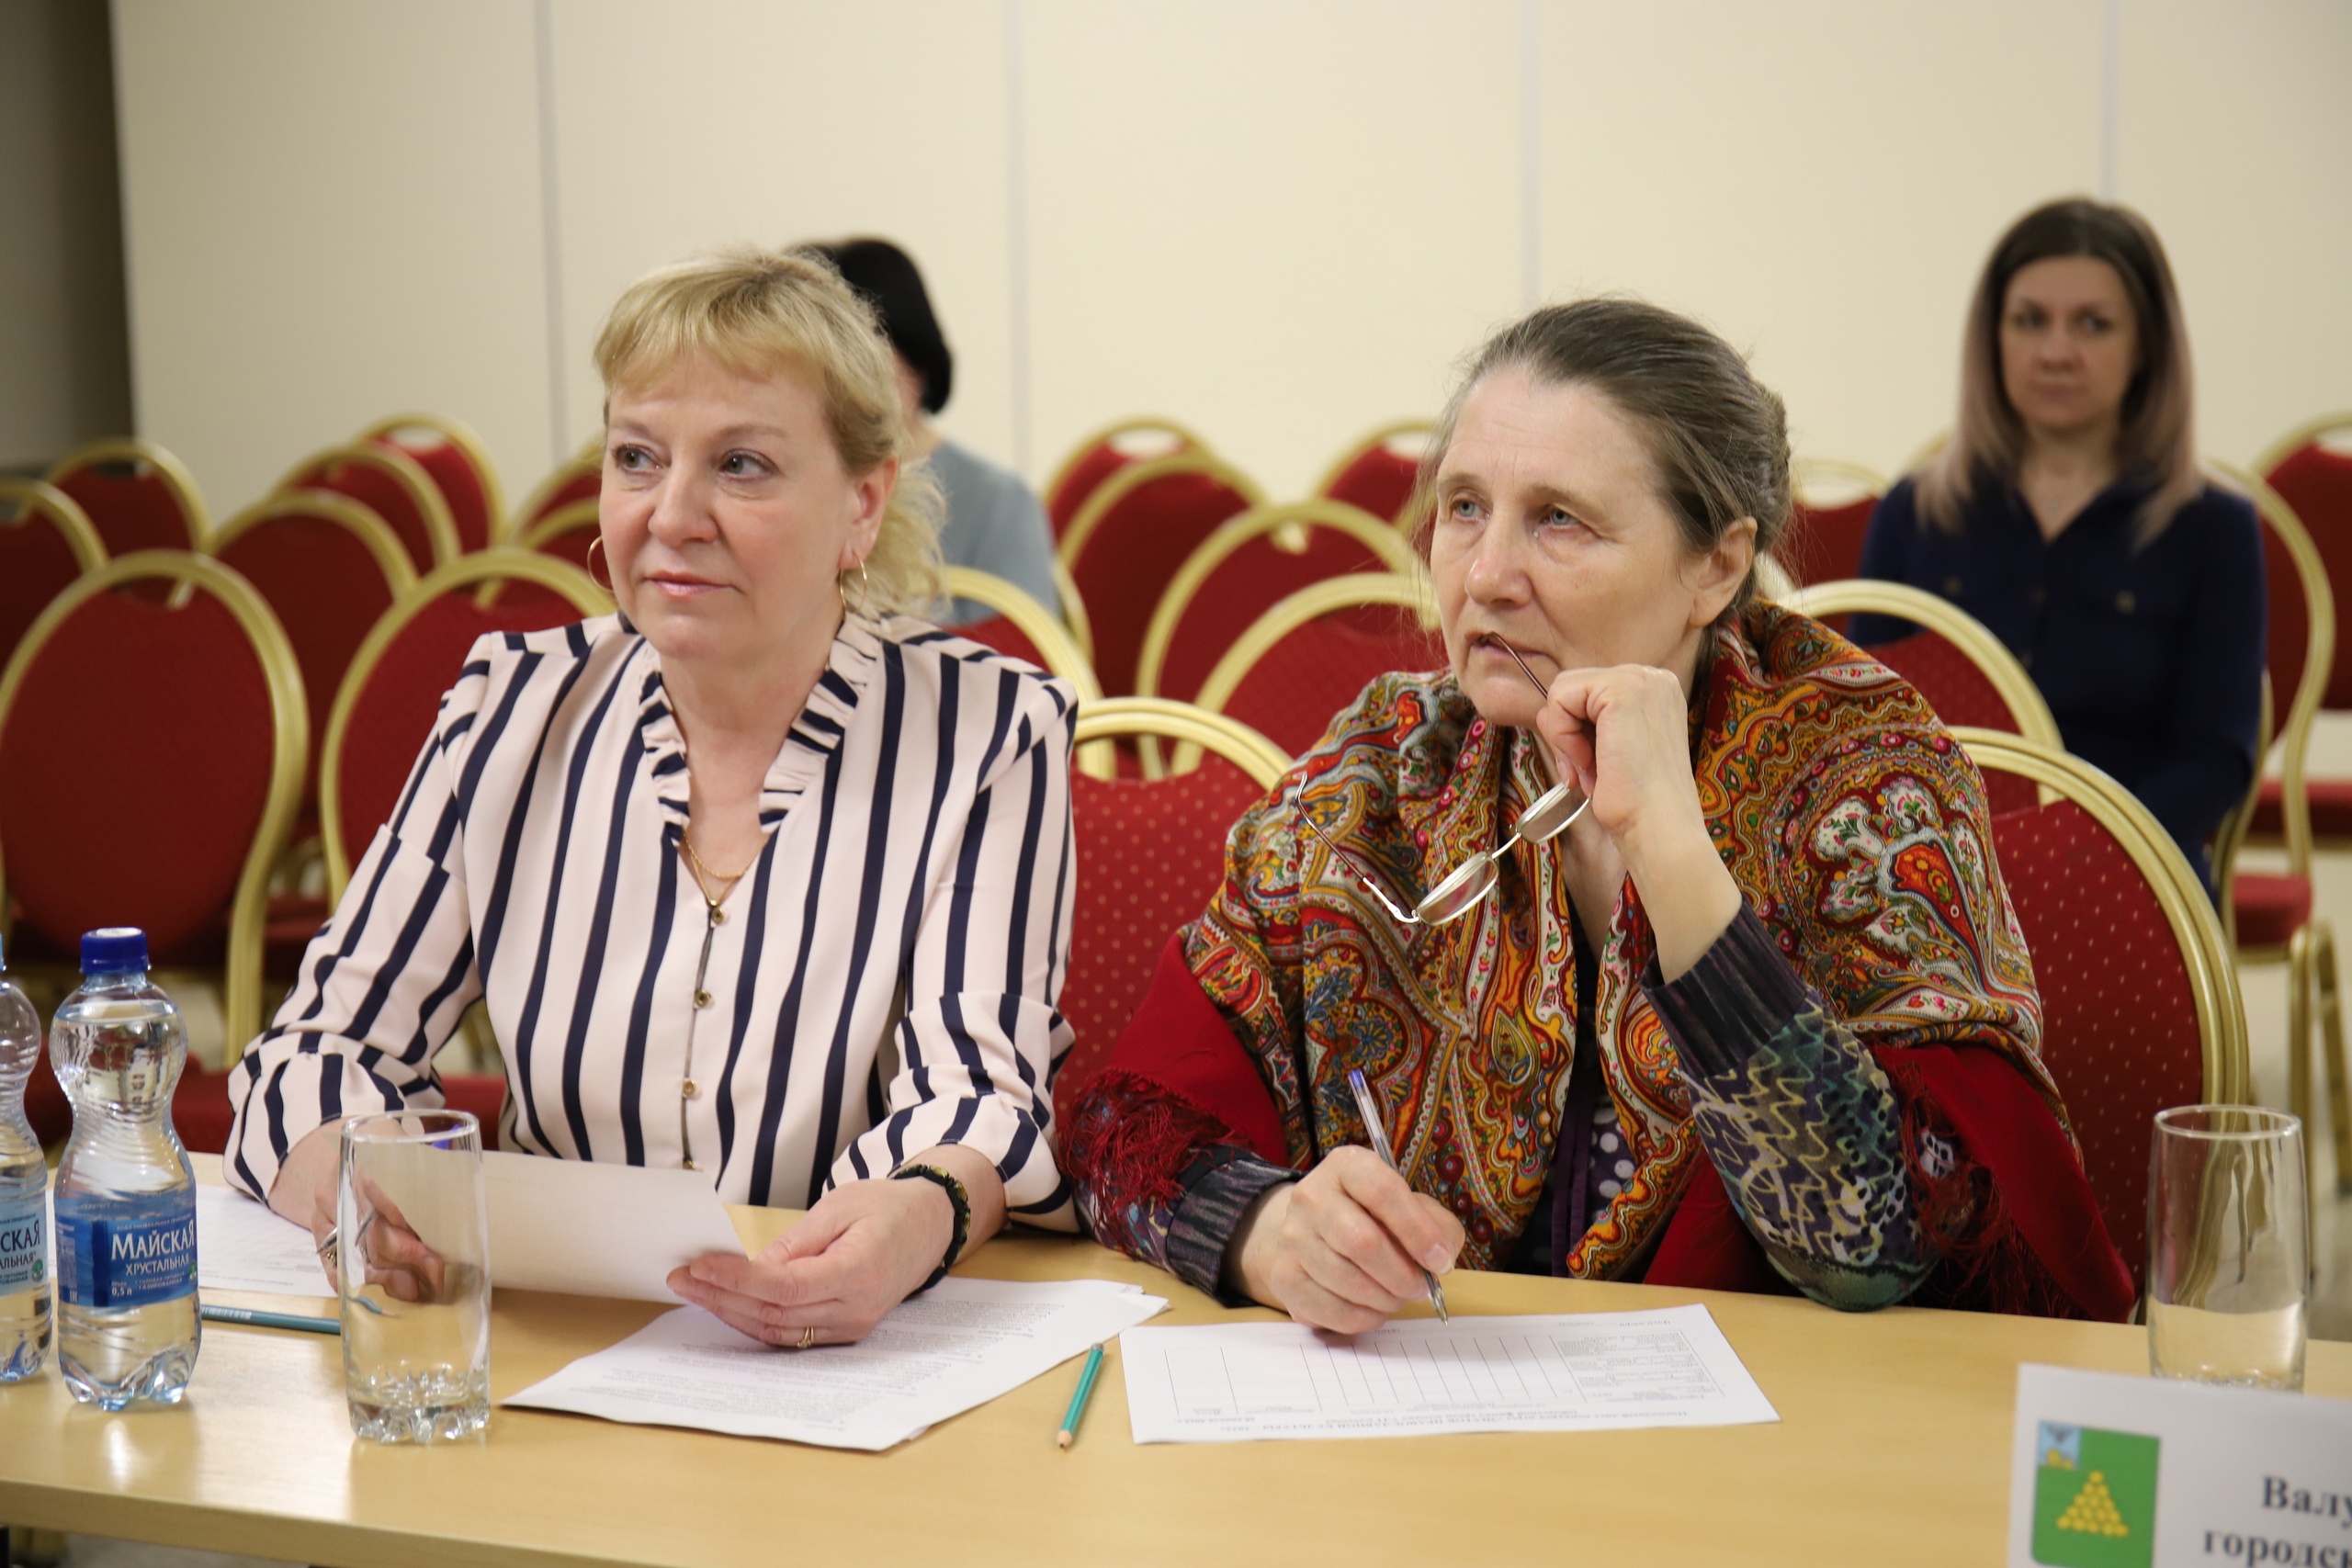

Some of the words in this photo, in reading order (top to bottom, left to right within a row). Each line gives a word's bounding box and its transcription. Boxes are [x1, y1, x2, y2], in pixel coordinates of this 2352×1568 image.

[111, 1219, 195, 1260] МАЙСКАЯ
[125, 1253, 189, 1276] ХРУСТАЛЬНАЯ
[111, 1287, 124, 1298] 0,5
[127, 1287, 132, 1297] л
